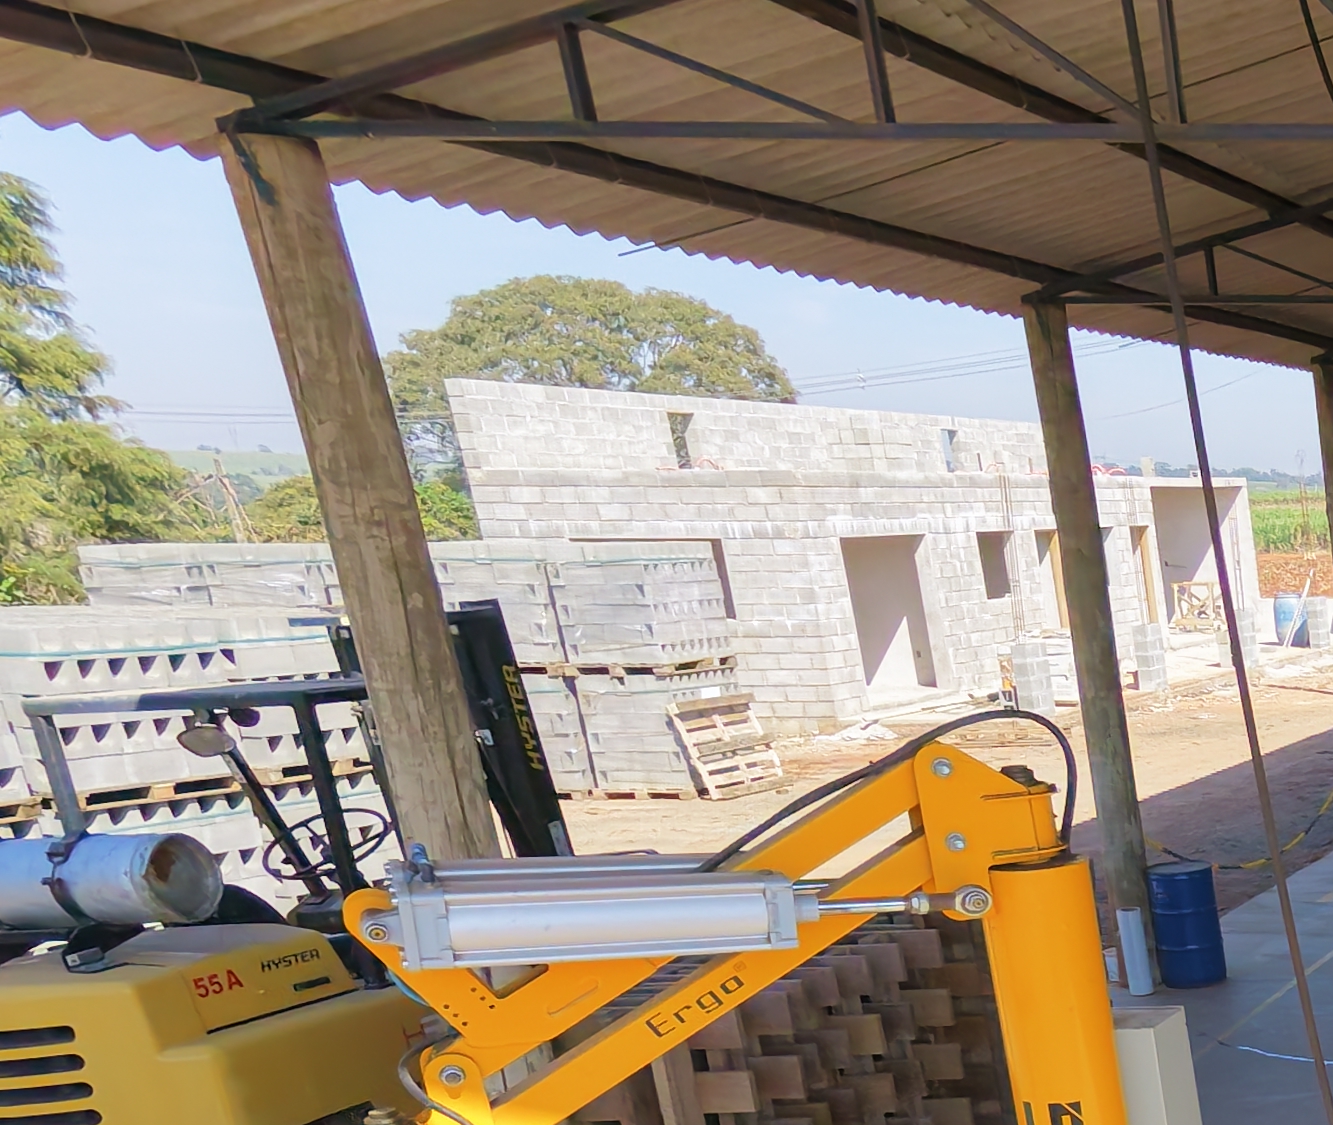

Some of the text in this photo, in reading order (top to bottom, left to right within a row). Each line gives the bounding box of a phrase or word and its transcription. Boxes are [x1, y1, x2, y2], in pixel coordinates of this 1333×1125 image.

[502, 664, 544, 770] HYSTER
[260, 948, 320, 973] HYSTER
[645, 975, 745, 1038] Ergo
